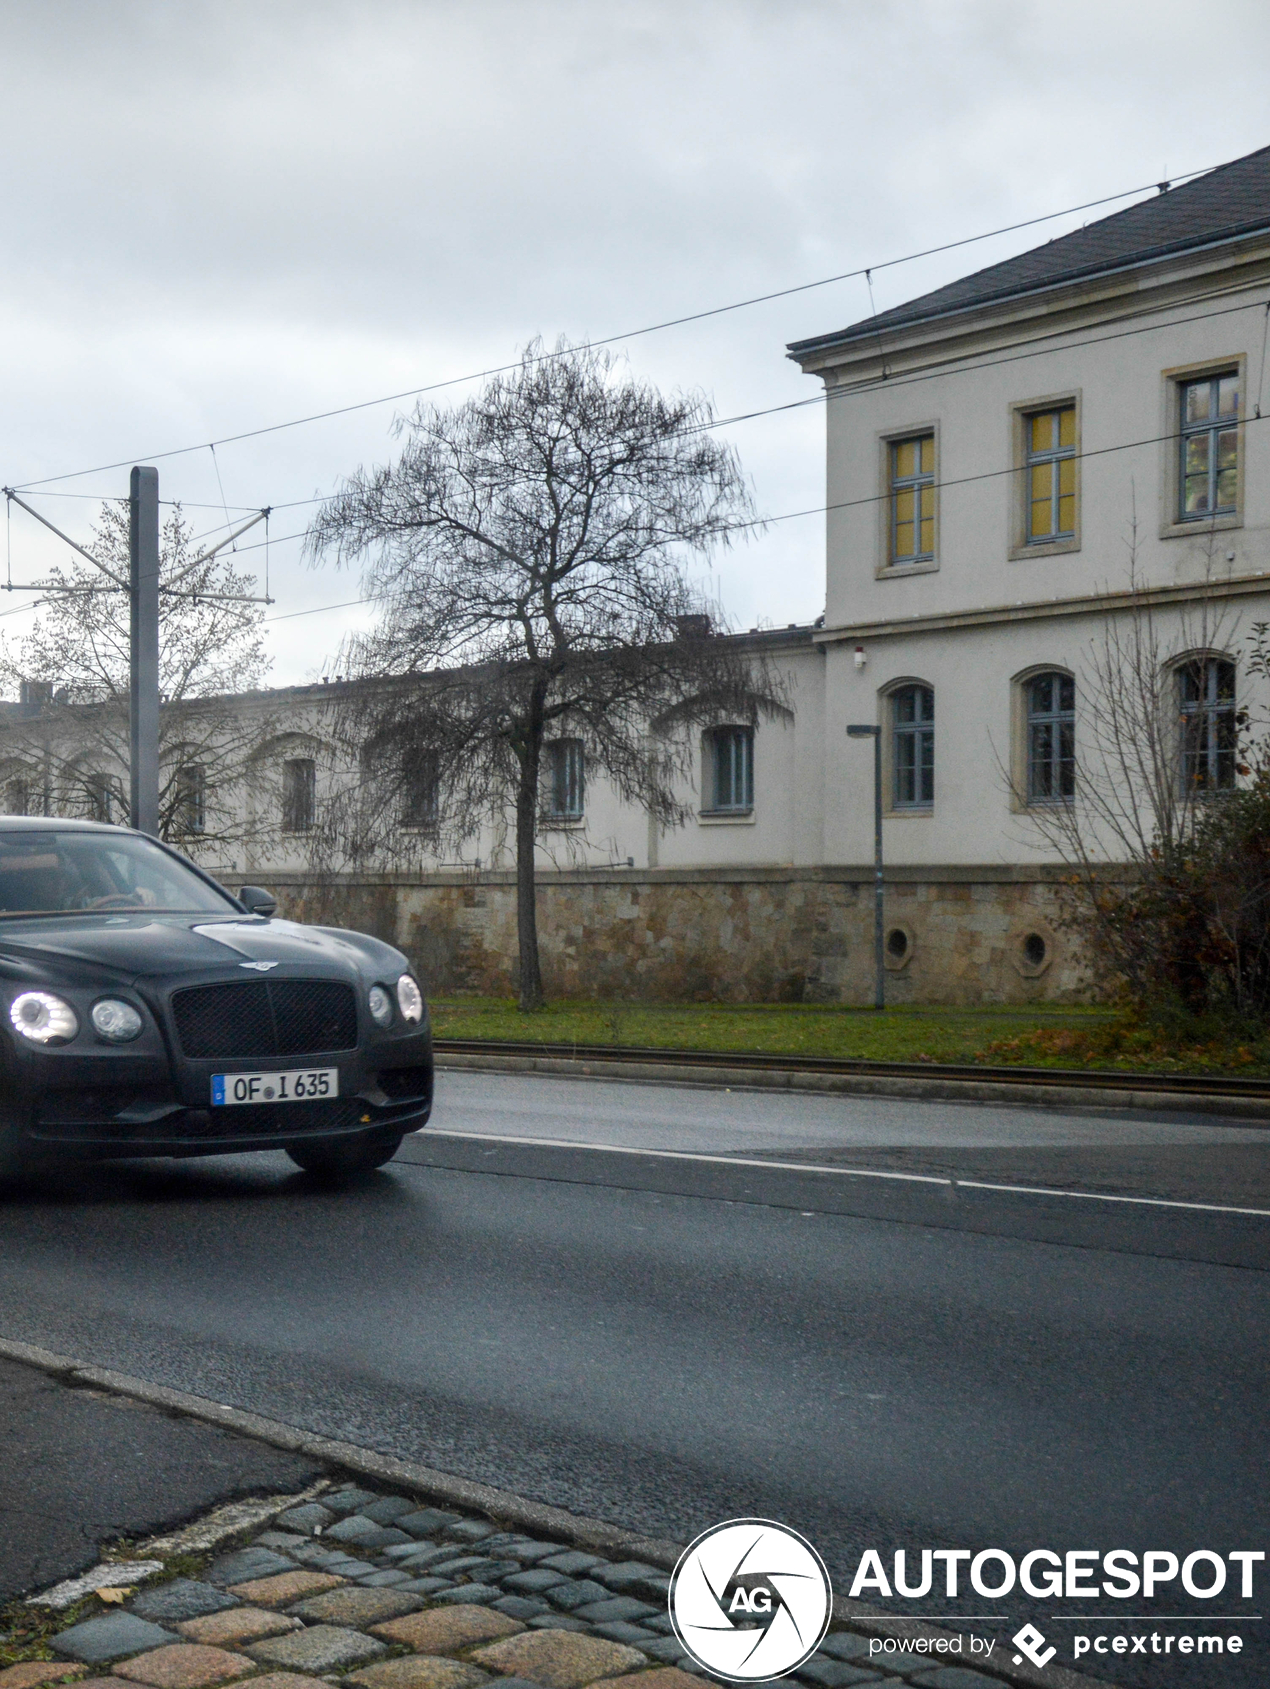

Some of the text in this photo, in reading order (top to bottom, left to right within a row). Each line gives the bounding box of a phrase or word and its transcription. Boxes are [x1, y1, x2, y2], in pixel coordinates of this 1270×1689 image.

[234, 1073, 329, 1101] OF I 635
